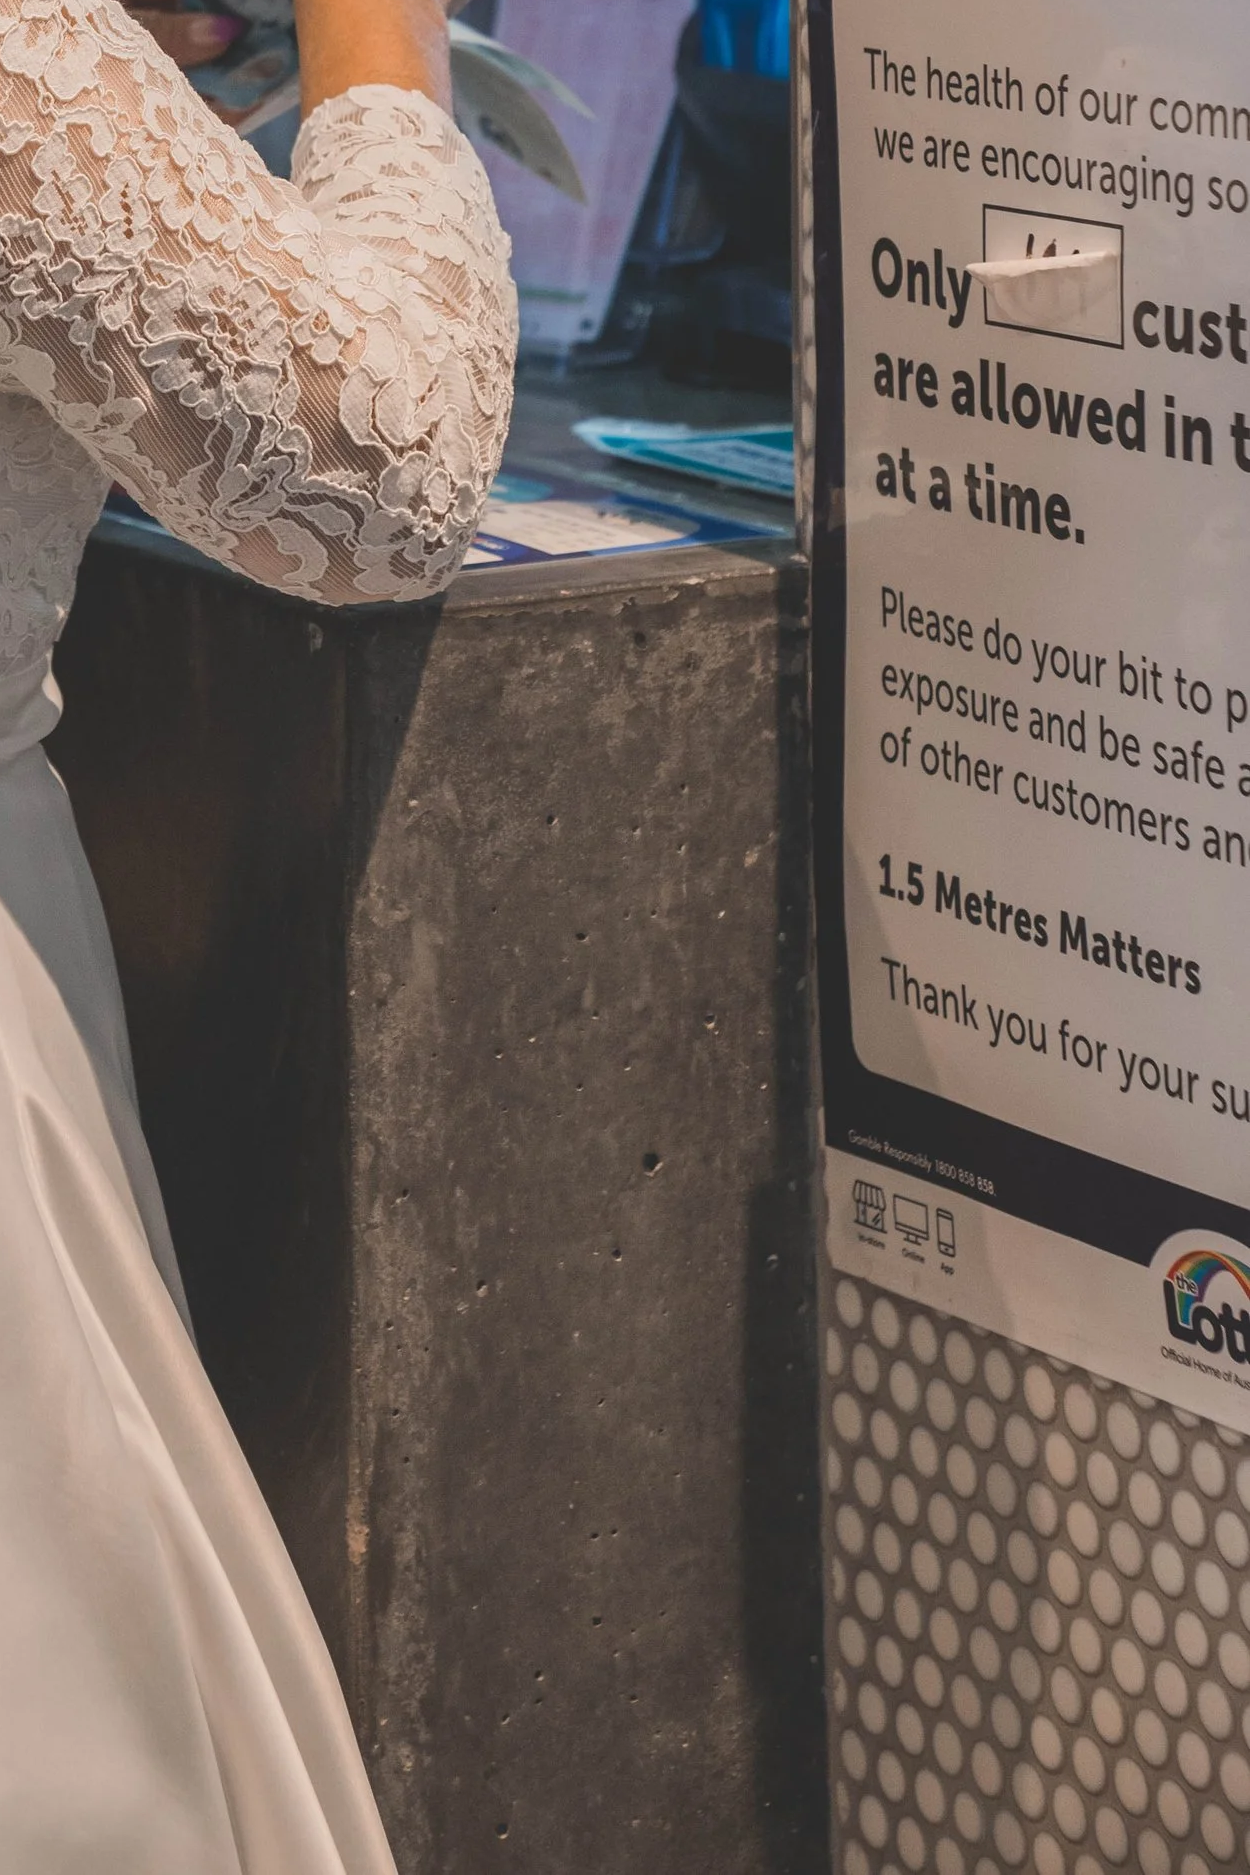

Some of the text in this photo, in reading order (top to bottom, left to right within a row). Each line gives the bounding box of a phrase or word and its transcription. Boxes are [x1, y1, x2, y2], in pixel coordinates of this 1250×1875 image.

[864, 47, 916, 96] The
[927, 56, 1023, 111] health
[1035, 74, 1069, 117] of
[1080, 88, 1138, 125] our
[874, 127, 914, 162] we
[924, 131, 970, 172] are
[982, 144, 1193, 217] encouraging
[871, 237, 972, 328] Only
[874, 352, 939, 409] are
[951, 358, 1146, 453] allowed
[1164, 394, 1213, 466] in
[876, 447, 1086, 545] at a time.
[881, 585, 973, 652] Please
[983, 617, 1022, 666] do
[1031, 638, 1107, 688] your
[1119, 649, 1163, 705] bit
[1174, 667, 1212, 715] to
[881, 663, 1019, 733] exposure
[1028, 709, 1086, 753] and
[1099, 714, 1141, 768] be
[1152, 739, 1225, 790] safe
[880, 725, 1250, 868] of other customers an
[878, 853, 1202, 995] 1.5 Metres Matters
[880, 955, 979, 1031] Thank
[986, 1002, 1047, 1055] you
[1058, 1018, 1108, 1074] for
[1117, 1046, 1199, 1104] your
[935, 1159, 957, 1180] 1800
[1176, 1273, 1199, 1294] the
